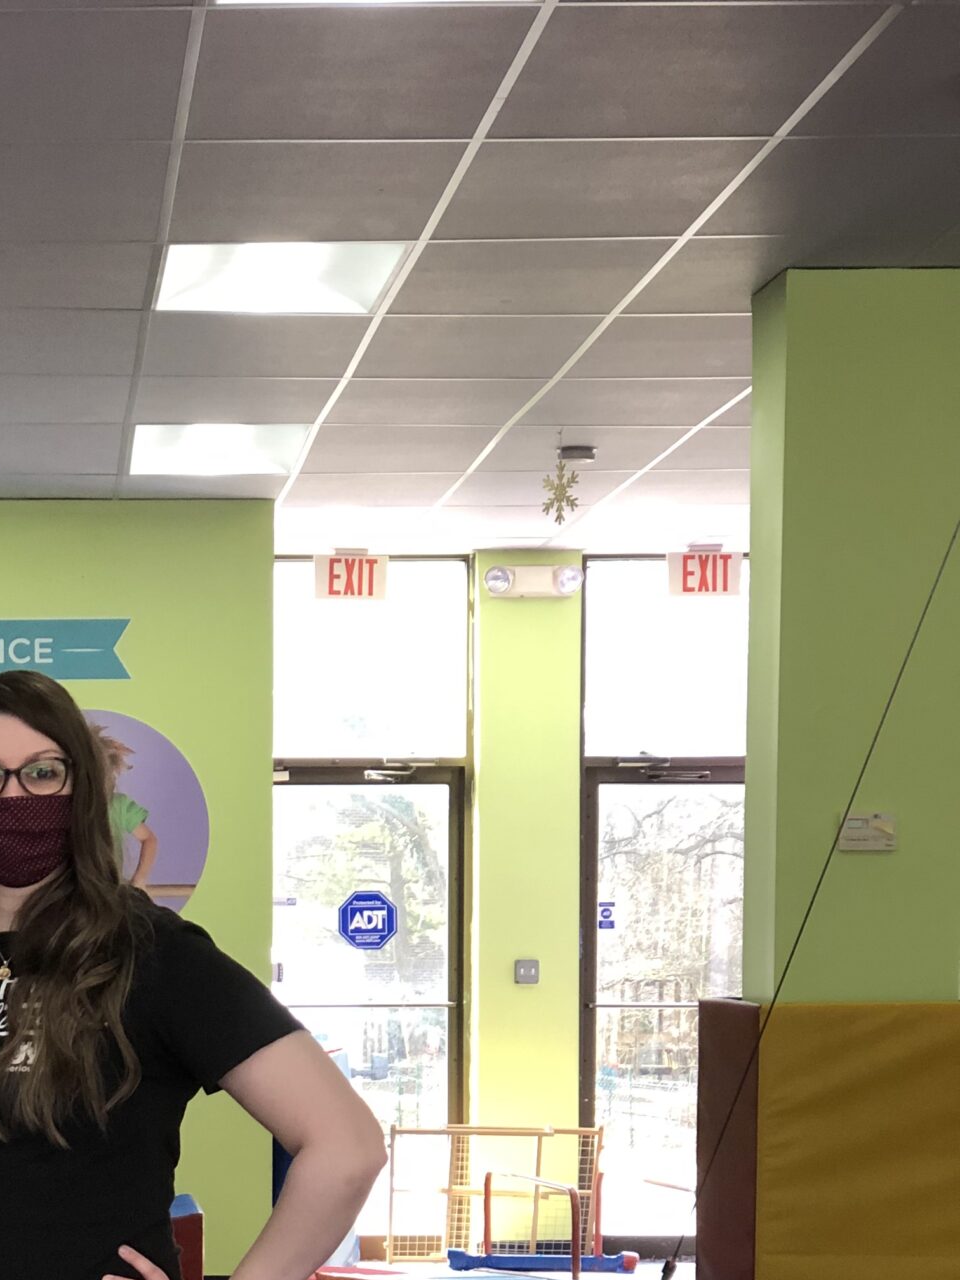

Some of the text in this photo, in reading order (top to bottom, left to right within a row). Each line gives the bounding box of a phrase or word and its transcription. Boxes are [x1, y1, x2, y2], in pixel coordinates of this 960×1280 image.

[328, 558, 378, 596] EXIT
[682, 554, 732, 592] EXIT
[349, 910, 387, 930] ADT
